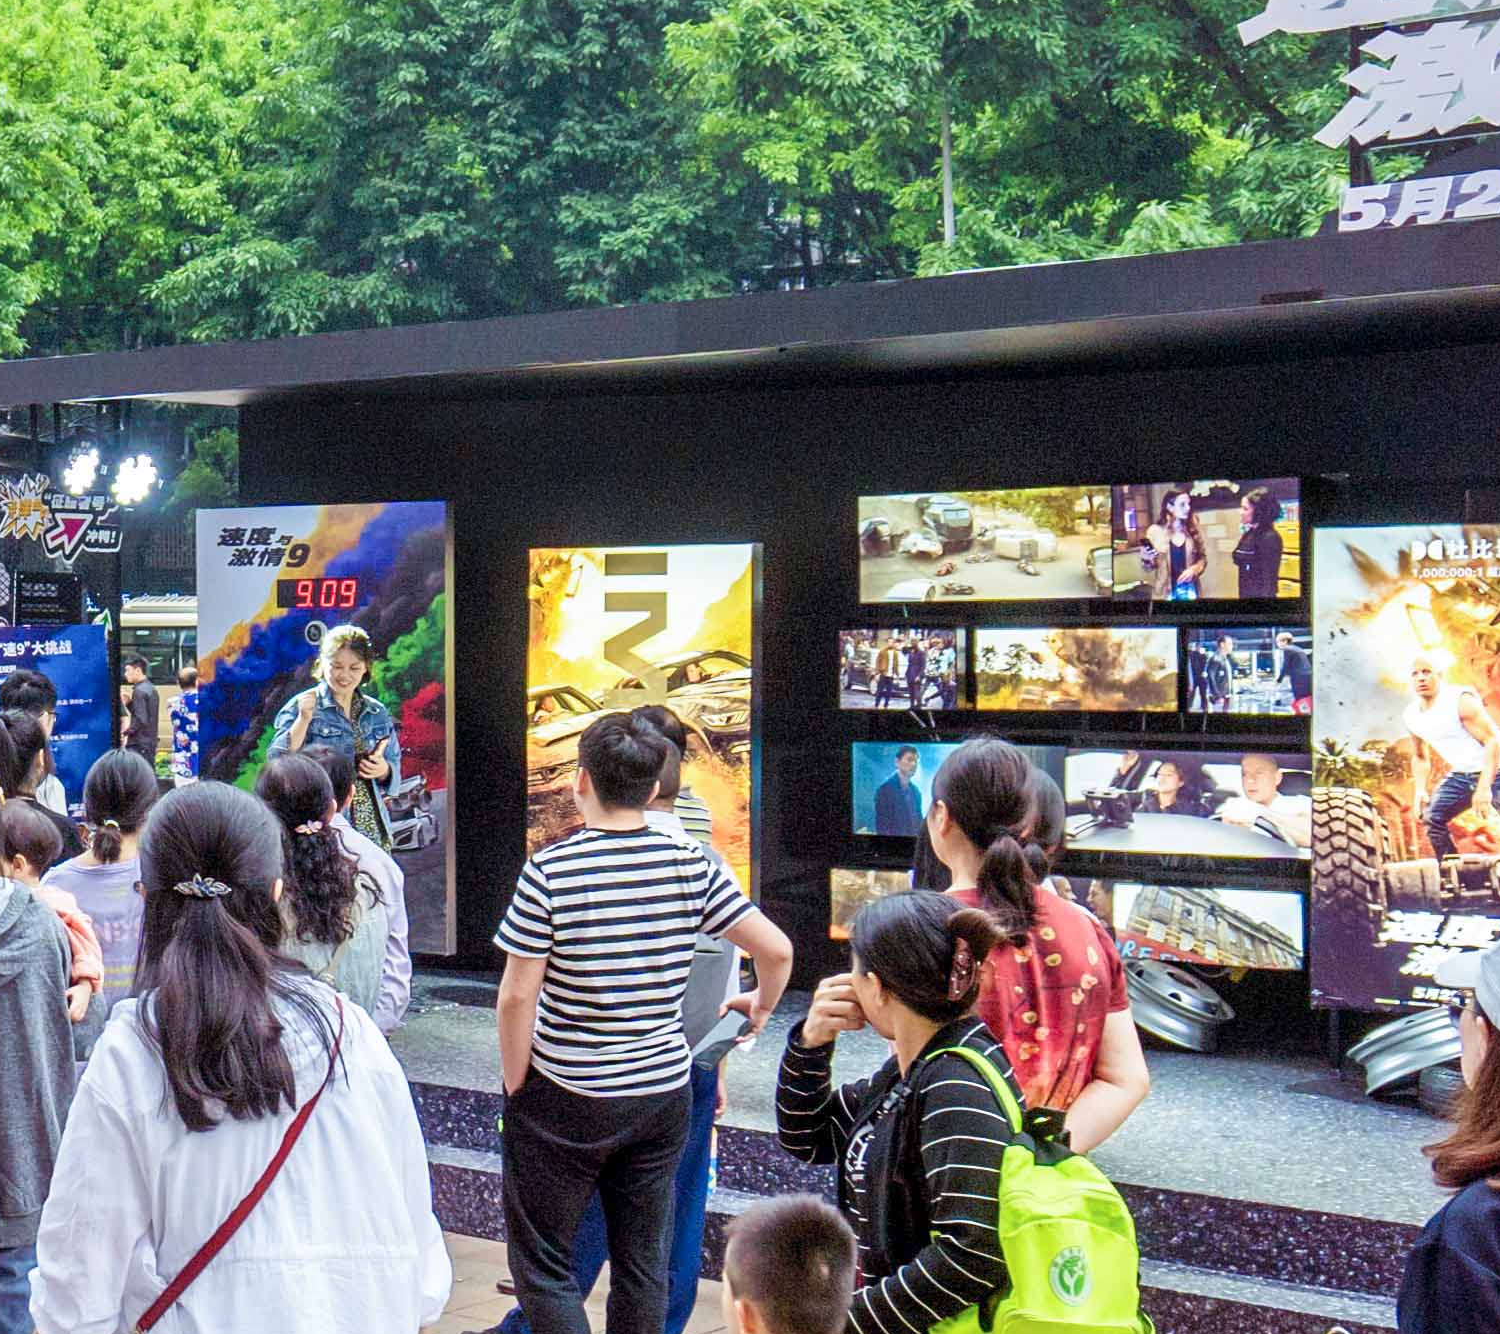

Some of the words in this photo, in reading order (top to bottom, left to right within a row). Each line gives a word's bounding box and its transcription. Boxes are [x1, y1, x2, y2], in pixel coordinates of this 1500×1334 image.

[217, 527, 293, 547] 速度与
[228, 543, 312, 568] 激情9
[604, 552, 668, 710] IM
